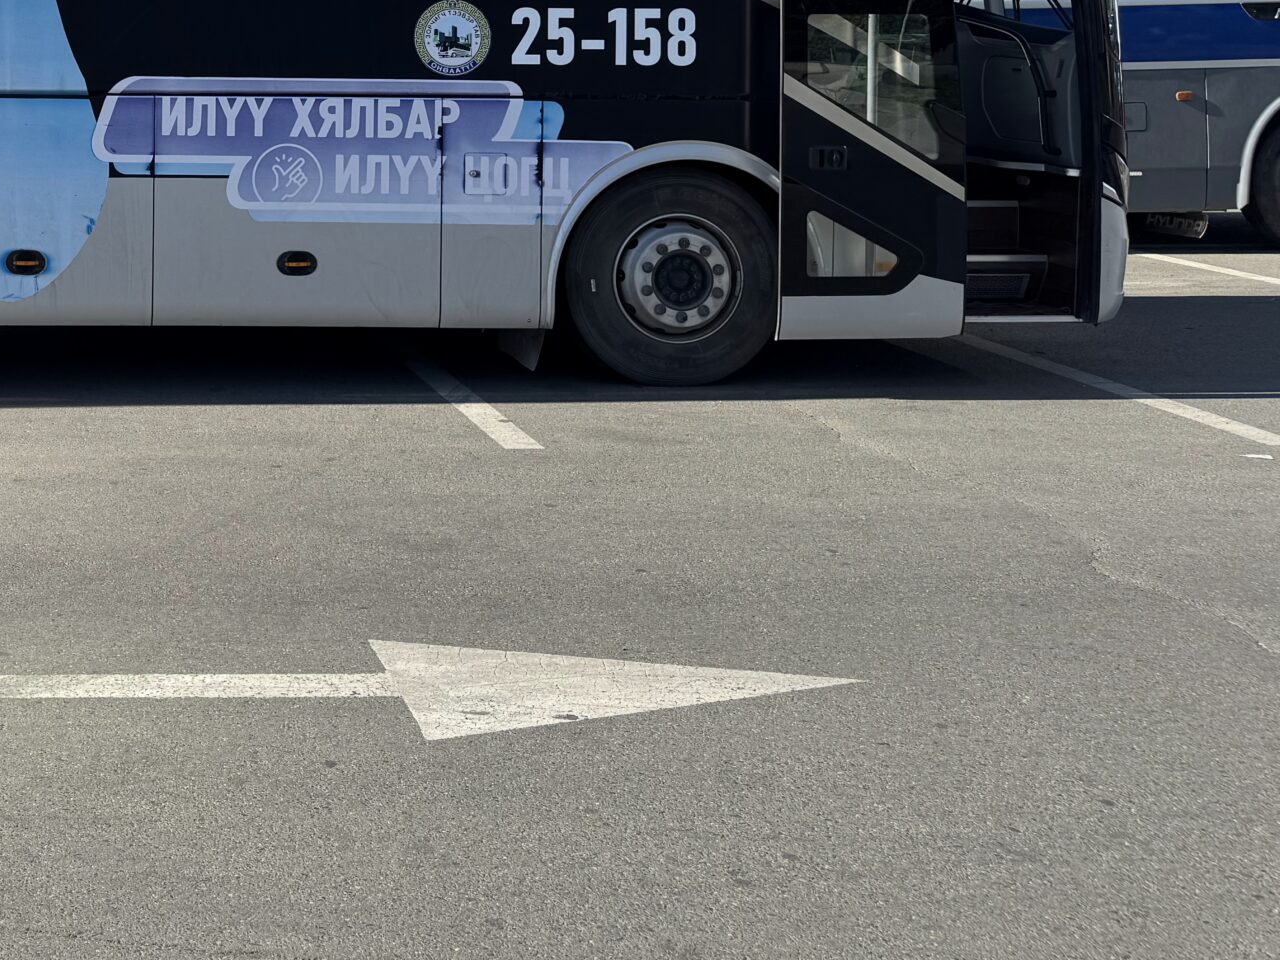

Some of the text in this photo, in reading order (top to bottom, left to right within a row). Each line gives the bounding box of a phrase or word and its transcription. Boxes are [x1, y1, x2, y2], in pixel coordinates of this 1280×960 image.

[510, 6, 698, 67] 25-158
[160, 96, 461, 140] ИЛҮҮ ХЯЛБАР
[334, 153, 571, 206] ИЛҮҮ ЦОГЦ
